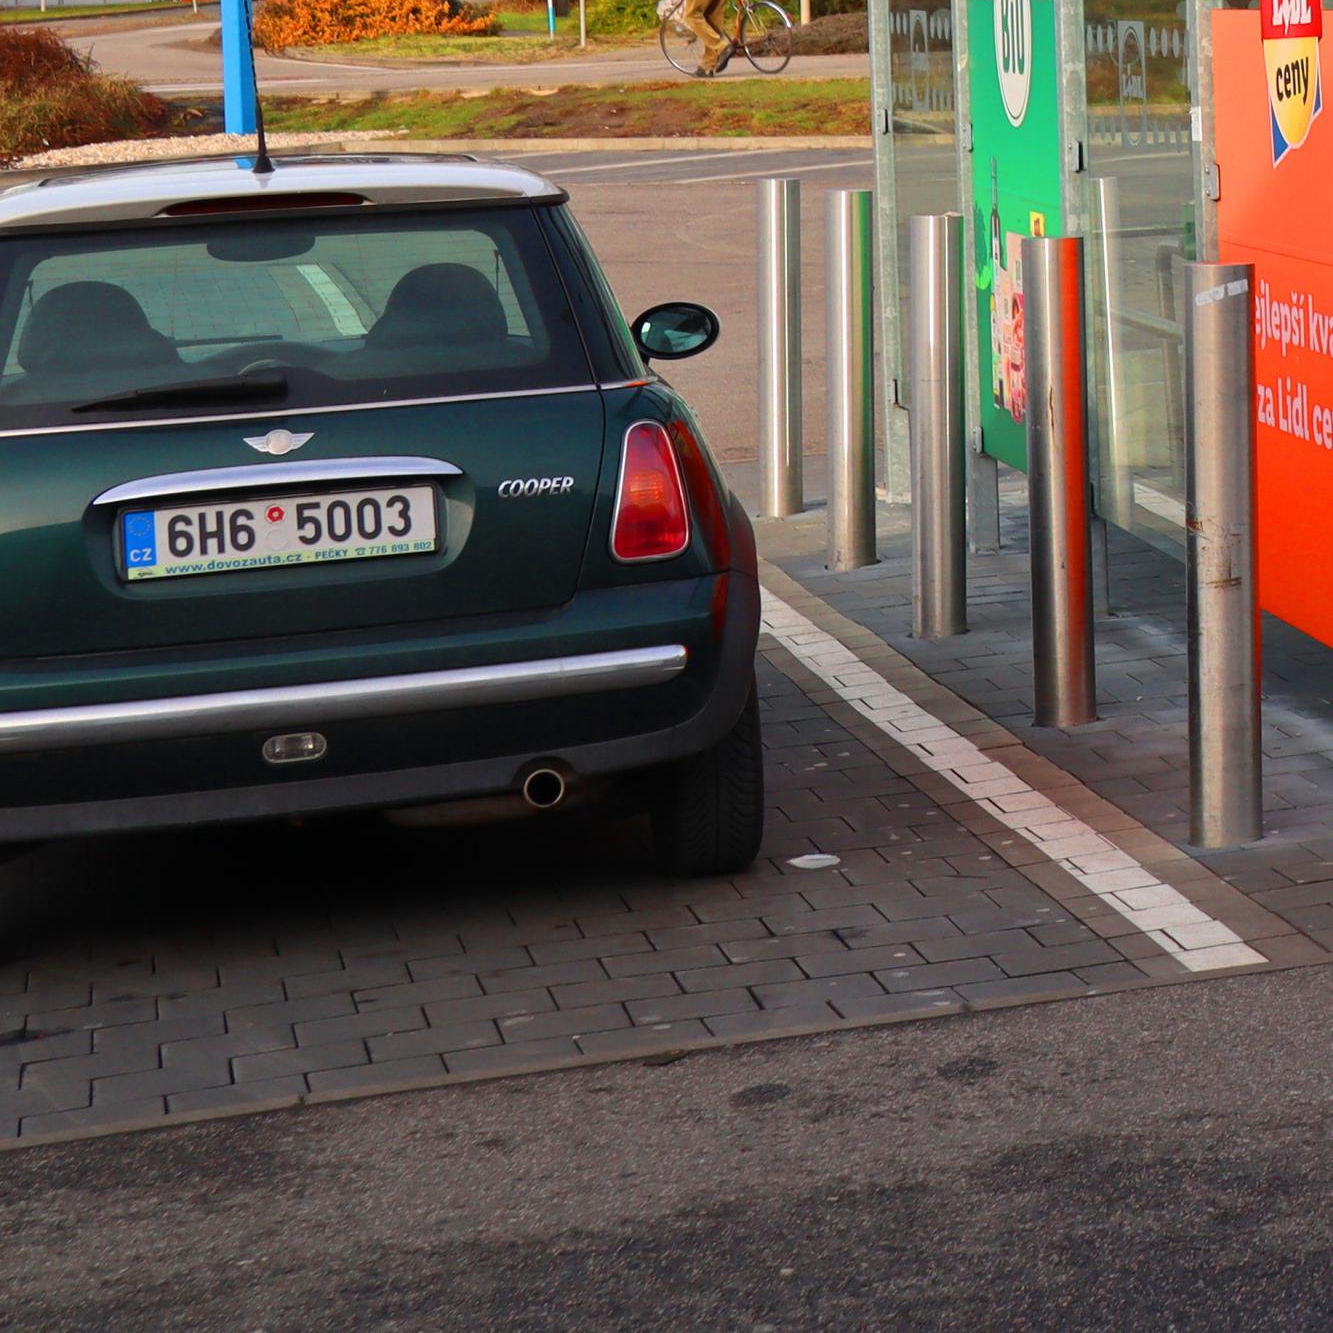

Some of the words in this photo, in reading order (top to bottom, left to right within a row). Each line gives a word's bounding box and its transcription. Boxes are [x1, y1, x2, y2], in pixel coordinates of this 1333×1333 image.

[1275, 56, 1309, 105] ceny
[1257, 384, 1275, 428] za
[1278, 376, 1310, 441] Lidl
[498, 476, 574, 497] COOPER
[168, 509, 255, 557] 6H6
[296, 495, 412, 545] 5003
[130, 548, 152, 562] CZ
[165, 553, 302, 574] www.dovozauta.cz
[369, 546, 387, 554] 776
